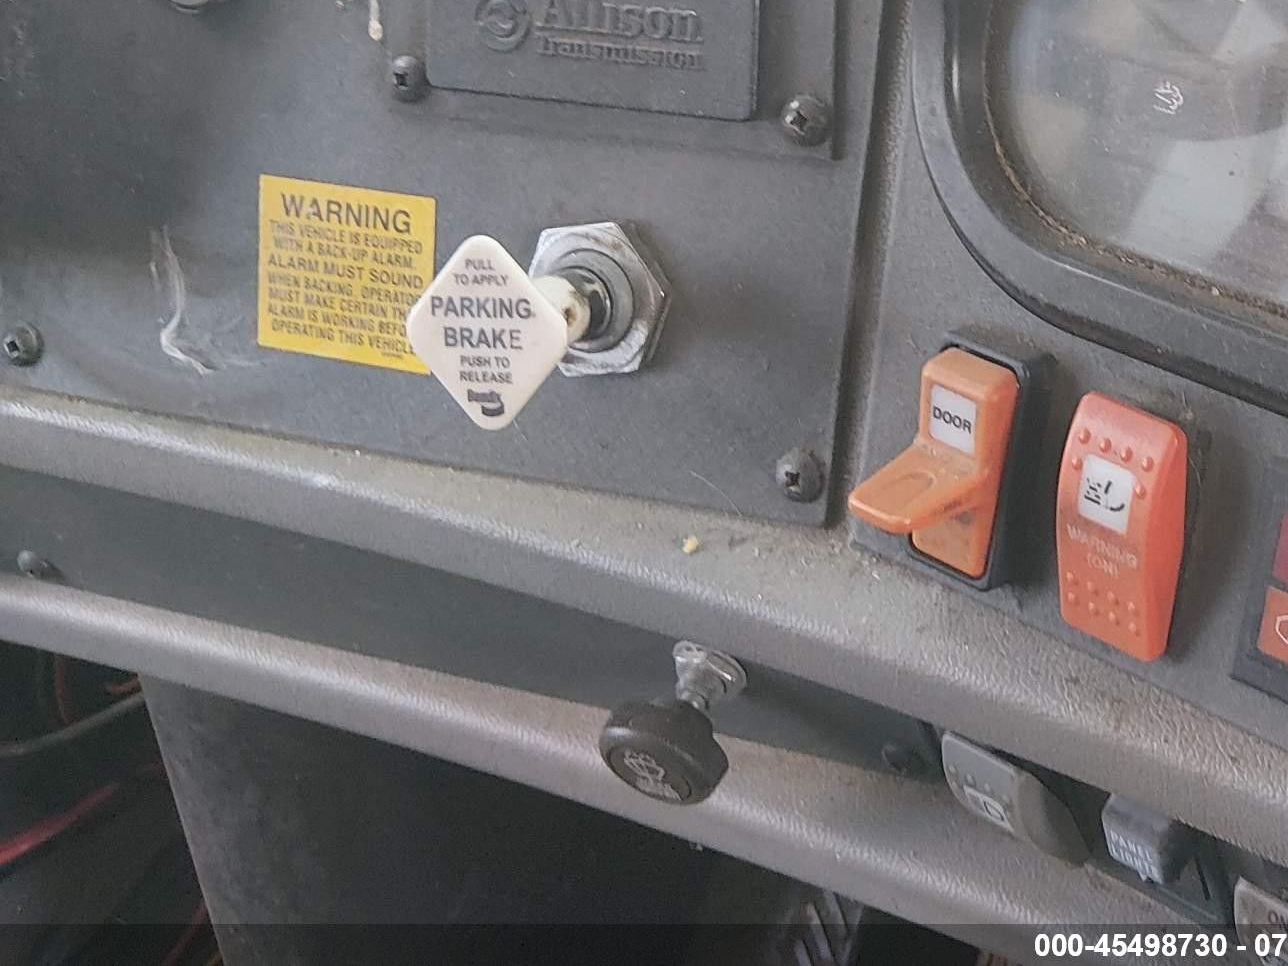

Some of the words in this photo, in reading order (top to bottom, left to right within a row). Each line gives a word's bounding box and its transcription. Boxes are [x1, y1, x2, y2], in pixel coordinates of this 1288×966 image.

[280, 192, 412, 234] WARNING
[269, 219, 295, 235] THIS
[300, 223, 345, 243] VEHICLE
[350, 230, 361, 245] IS
[364, 232, 423, 255] EQUIPPED
[273, 236, 303, 252] WITH
[305, 240, 314, 253] A
[318, 241, 368, 262] BACK-UP
[268, 253, 319, 273] ALARM
[323, 262, 366, 280] MUST
[369, 268, 423, 290] SOUND
[465, 258, 494, 271] PULL
[267, 272, 299, 288] WHEN
[360, 286, 420, 306] OPERATO
[453, 273, 468, 285] TO
[472, 274, 508, 286] APPLY
[267, 287, 299, 304] MUST
[303, 292, 336, 308] MAKE
[340, 298, 388, 318] CERTAIN
[431, 295, 533, 320] PARKING
[267, 303, 304, 320] ALARM
[307, 308, 319, 322] IS
[322, 311, 375, 332] WORKING
[272, 319, 336, 342] OPERATING
[340, 332, 364, 347] THIS
[443, 326, 523, 350] BRAKE
[460, 355, 490, 367] PUSH
[494, 356, 510, 368] TO
[459, 371, 513, 384] RELEASE
[933, 405, 972, 434] DOOR
